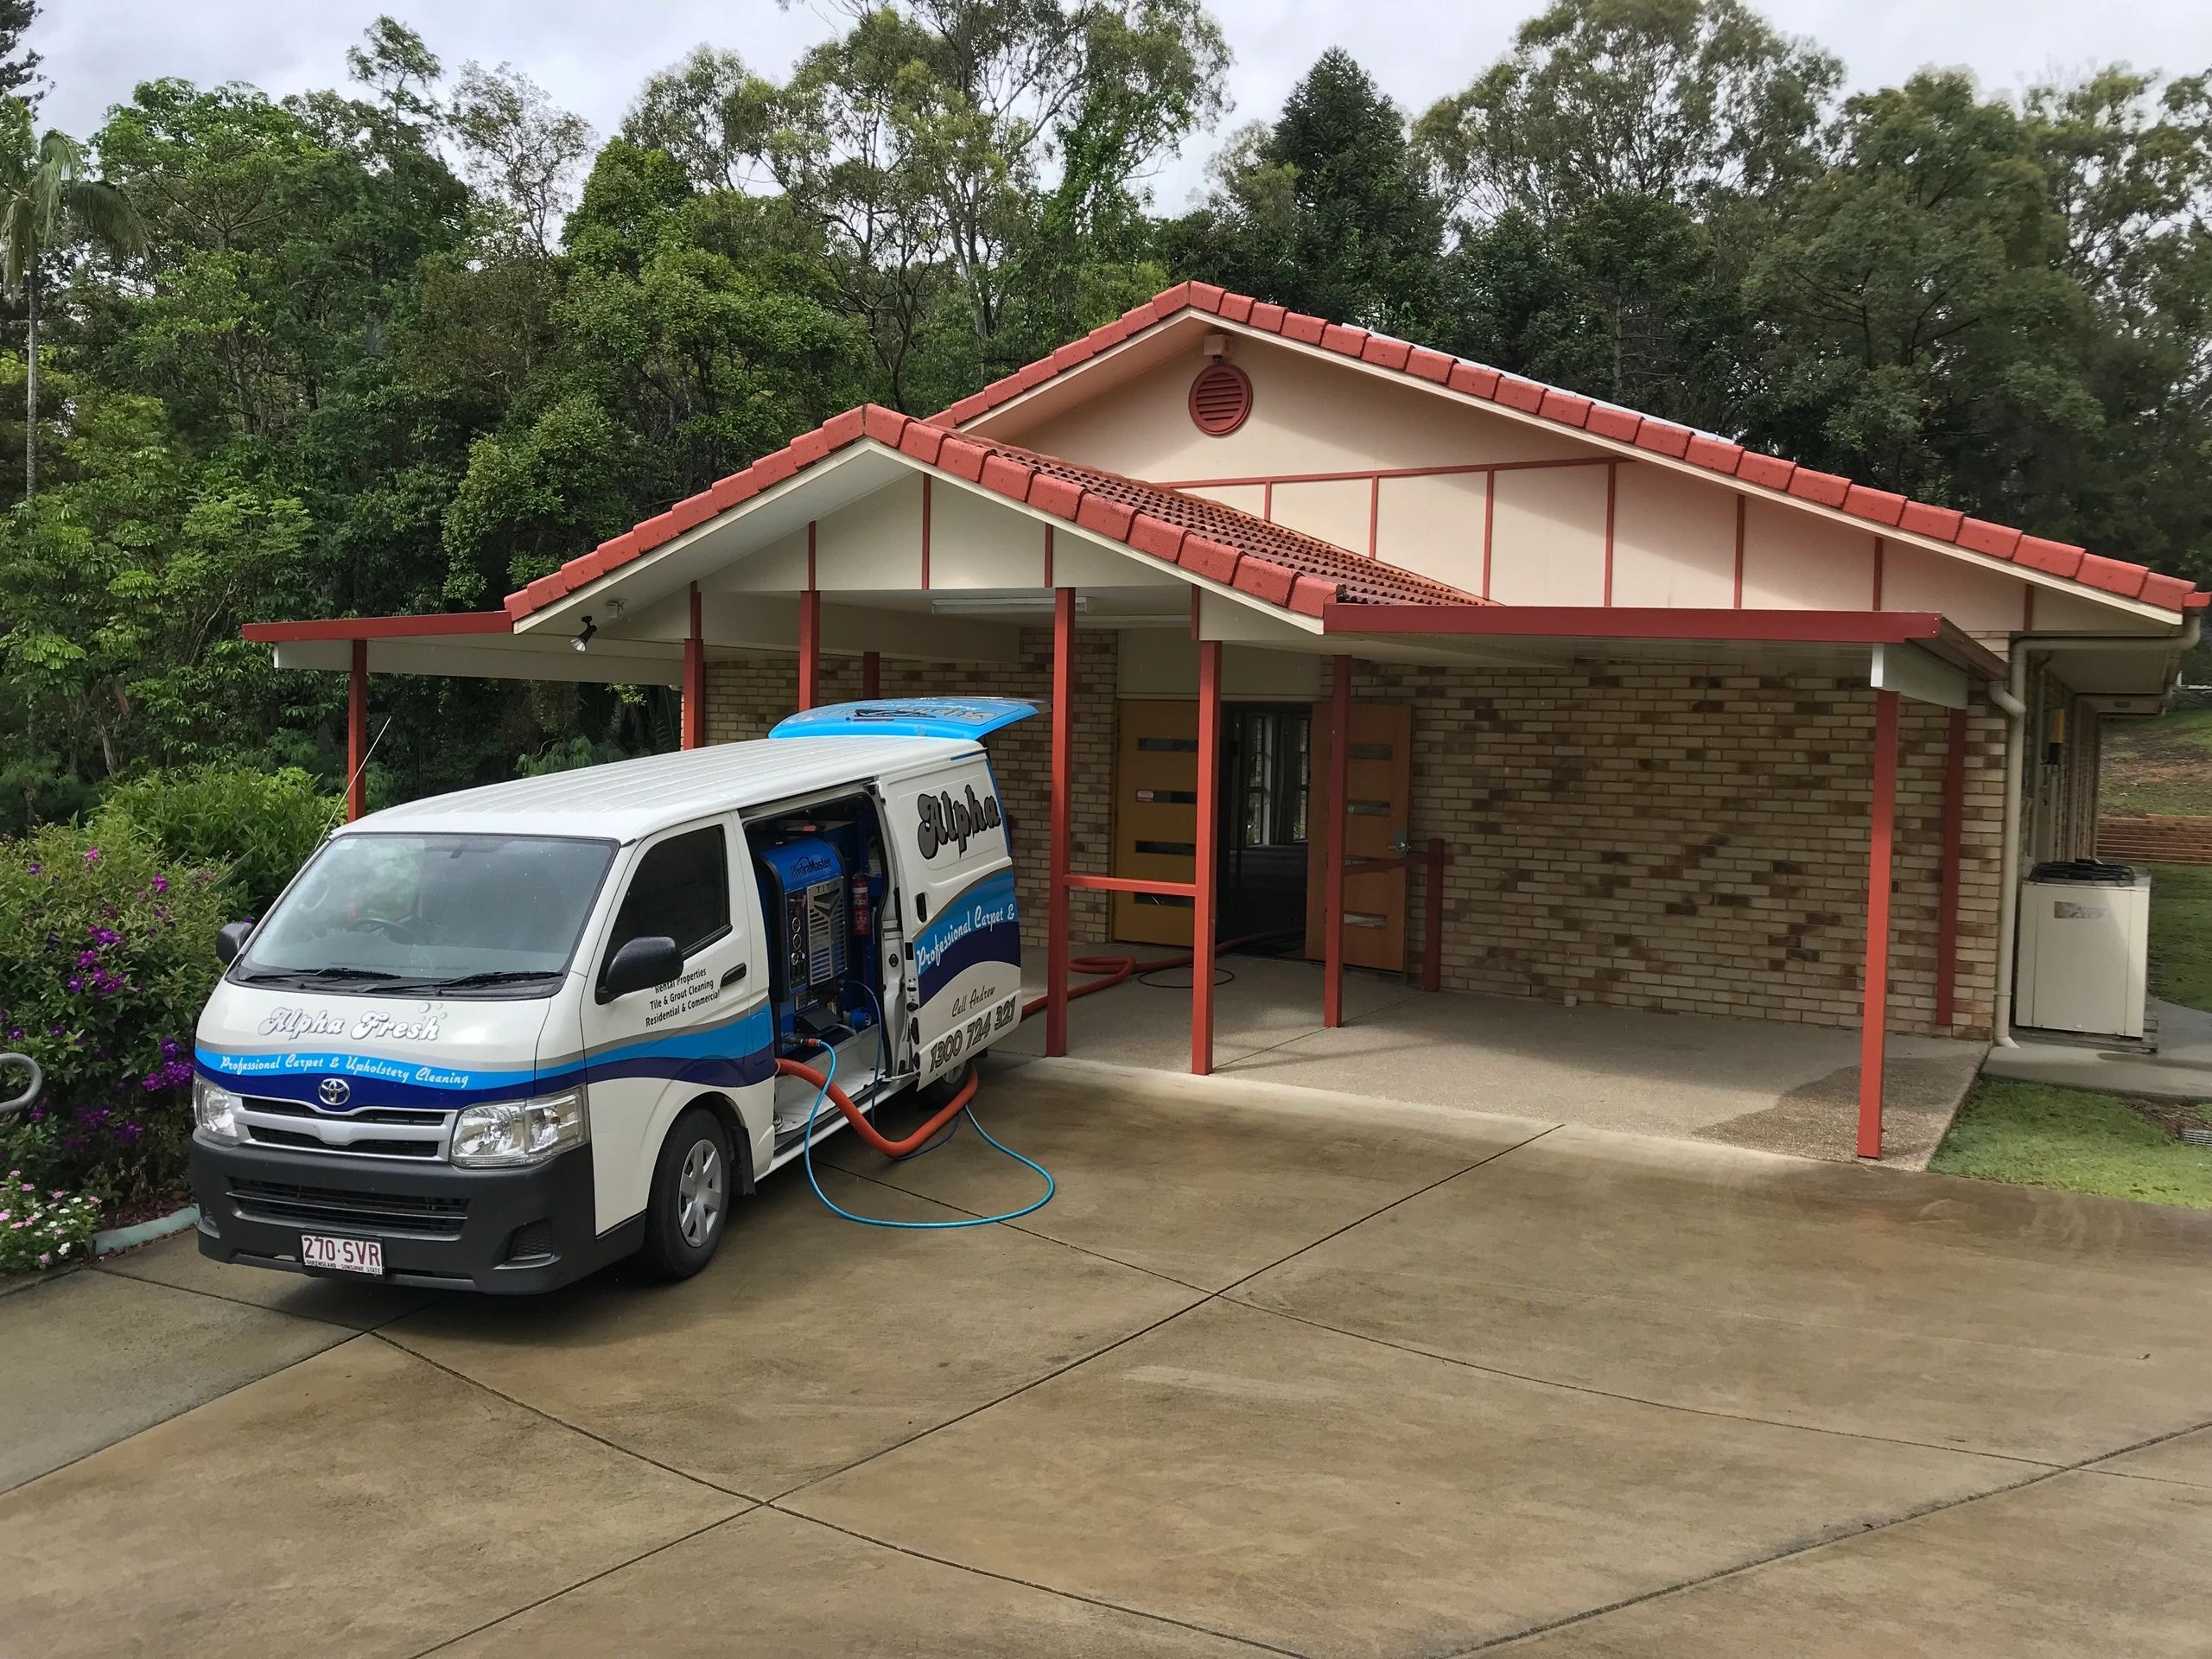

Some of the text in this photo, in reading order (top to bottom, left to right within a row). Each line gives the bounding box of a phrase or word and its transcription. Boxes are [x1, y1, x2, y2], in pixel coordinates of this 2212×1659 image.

[917, 784, 1001, 860] Alpha
[916, 903, 1015, 974] Professional Carpet &
[649, 979, 714, 1010] Tile & Grout Cleaning
[654, 969, 707, 994] Rental Properties
[645, 989, 720, 1027] Residential & Commercial
[951, 984, 995, 1018] Call Andrew
[257, 1007, 439, 1040] Alpha Fresh
[929, 995, 1017, 1073] 1300 724 321
[219, 1053, 469, 1089] Professional Carpet & Upholstery Cleaning
